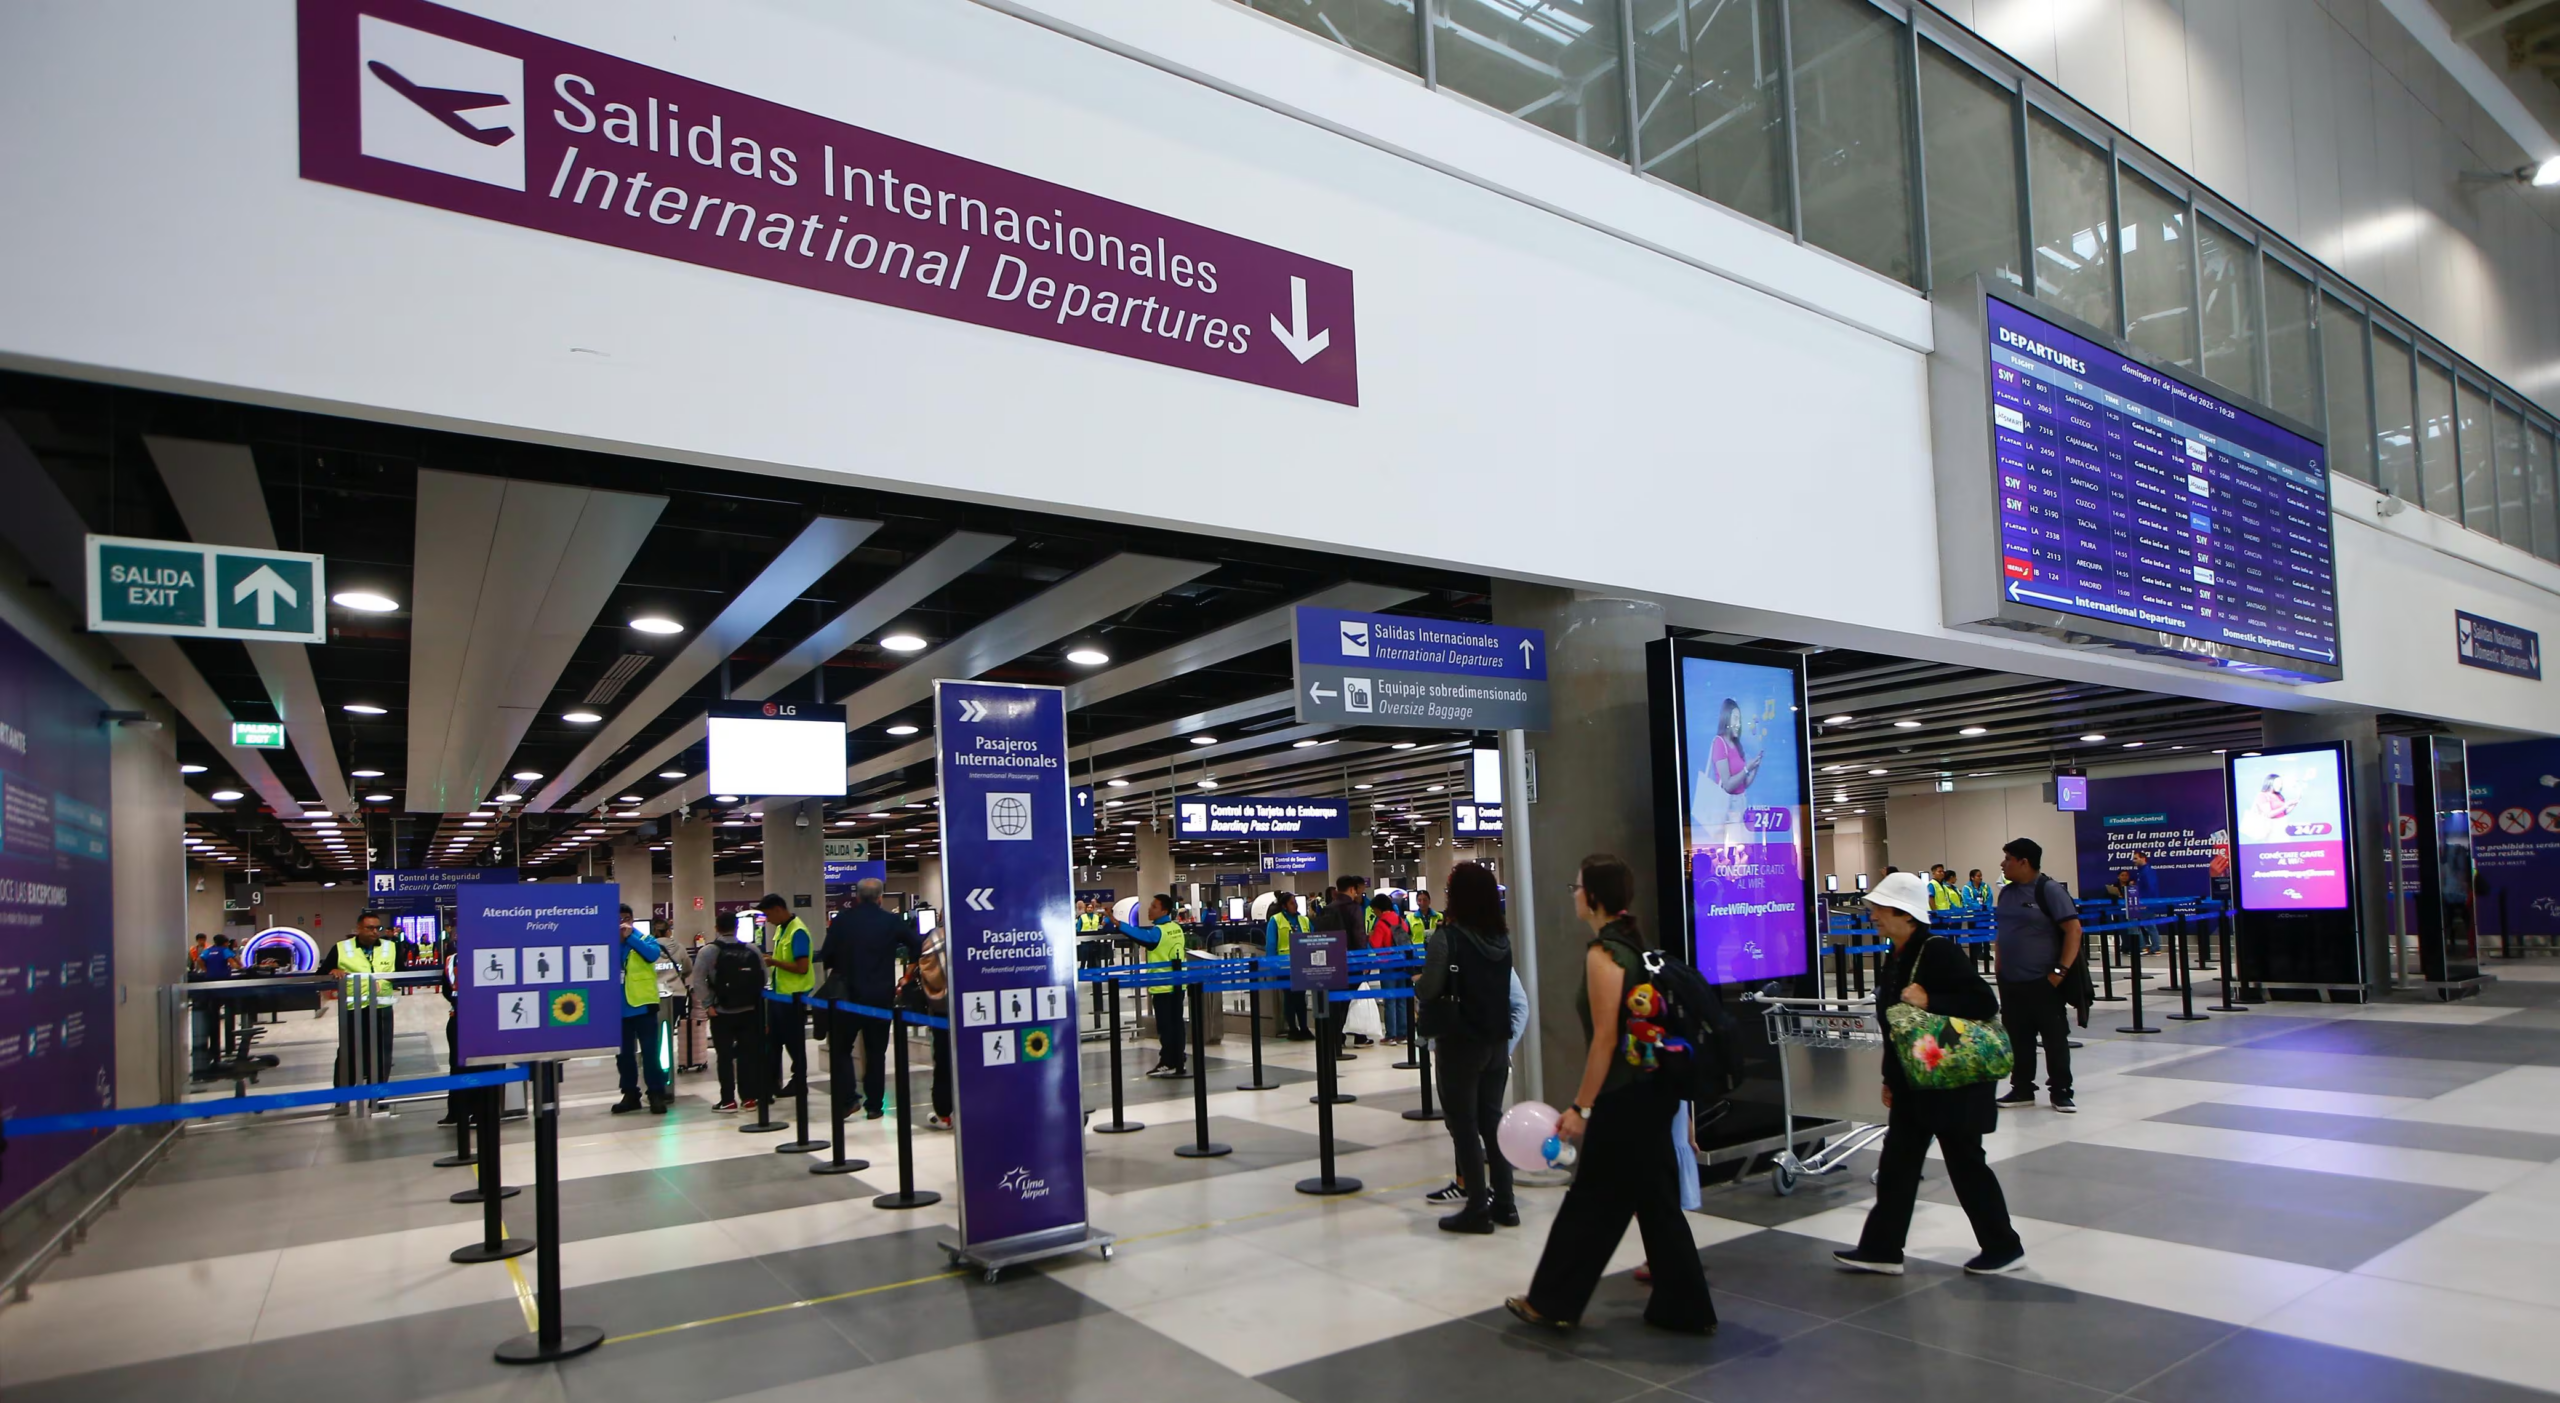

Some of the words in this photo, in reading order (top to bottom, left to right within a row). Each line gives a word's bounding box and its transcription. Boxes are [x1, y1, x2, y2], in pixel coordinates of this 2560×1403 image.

[553, 73, 798, 186] Salidas
[824, 145, 1219, 294] Internacionales
[549, 146, 971, 290] International
[986, 253, 1252, 354] Departures
[1999, 326, 2086, 375] DEPARTURES
[1998, 368, 2014, 383] SKY
[2021, 378, 2031, 387] H2
[2036, 384, 2048, 393] 803
[2065, 395, 2094, 411] SANTIAGO
[2010, 355, 2035, 371] FLIGHT
[2073, 381, 2083, 390] TO
[2104, 394, 2120, 406] TIME
[2126, 403, 2142, 415] GATE
[2157, 416, 2174, 427] STATE
[2121, 364, 2151, 383] domingo
[2152, 377, 2161, 387] 01
[2162, 381, 2171, 391] de
[2171, 384, 2187, 399] junio
[2188, 393, 2198, 403] del
[2198, 397, 2214, 411] 2025
[2219, 406, 2235, 419] 10:28
[2023, 398, 2031, 406] LA
[2038, 404, 2052, 414] 2063
[2070, 416, 2091, 428] CUZCO
[2039, 426, 2053, 436] 7318
[2065, 436, 2098, 452] CAJAMARCA
[2040, 447, 2055, 457] 2450
[2065, 456, 2084, 468] PUNTA
[2085, 463, 2101, 473] CANA
[2191, 462, 2203, 474] SKY
[2027, 463, 2035, 471] LA
[2041, 468, 2052, 476] 645
[2070, 477, 2099, 491] SANTIAGO
[2005, 476, 2021, 489] SKY
[2028, 484, 2037, 492] H2
[2043, 488, 2057, 498] 5015
[2075, 498, 2096, 510] CUZCO
[2006, 498, 2022, 511] SKY
[2030, 505, 2039, 514] H2
[2044, 509, 2059, 519] 5190
[2077, 519, 2097, 530] TACNA
[2031, 527, 2039, 535] LA
[2045, 531, 2060, 540] 2338
[2080, 540, 2096, 550] PIURA
[2032, 548, 2040, 556] LA
[2046, 552, 2061, 561] 2113
[2076, 559, 2103, 571] AREQUIPA
[111, 564, 195, 588] SALIDA
[2007, 564, 2023, 573] IBERIA
[2048, 572, 2059, 581] 124
[2079, 579, 2102, 590] MADRID
[128, 587, 179, 607] EXIT
[2075, 596, 2137, 618] International
[2139, 609, 2186, 628] Departures
[1374, 623, 1415, 641] Salidas
[1419, 627, 1499, 649] Internacionales
[2222, 628, 2257, 644] Domestic
[2258, 635, 2295, 651] Departures
[2472, 622, 2494, 643] Salidas
[2493, 627, 2523, 650] Nacionales
[1375, 644, 1446, 663] International
[1448, 650, 1503, 668] Departures
[2475, 642, 2500, 663] Domestic
[2500, 649, 2529, 670] Departures
[1378, 679, 1425, 698] Equipaje
[1429, 683, 1528, 701] sobredimensionado
[779, 705, 796, 716] LG
[1379, 699, 1424, 715] Oversize
[1428, 702, 1473, 721] Baggage
[976, 736, 1037, 754] Pasajeros
[955, 751, 1058, 768] Internacionales
[1007, 773, 1039, 781] Passengers
[1210, 804, 1242, 817] Control
[1244, 805, 1255, 817] de
[1255, 805, 1285, 819] Tarjeta
[1286, 805, 1297, 817] de
[1298, 805, 1338, 819] Embarque
[1754, 812, 1784, 829] 24/7
[2109, 815, 2164, 824] #TodoBajoControl
[1210, 820, 1249, 834] Boarding
[1250, 821, 1270, 831] Pass
[1271, 820, 1301, 831] Control
[2107, 833, 2124, 841] Ten
[2136, 831, 2147, 839] la
[2149, 831, 2180, 839] mano
[2182, 829, 2194, 837] tu
[2294, 825, 2324, 835] 24/7
[825, 844, 850, 856] SALIDA
[2107, 840, 2165, 850] documento
[2168, 838, 2182, 848] de
[2183, 837, 2229, 847] identida
[2107, 853, 2113, 861] y
[2116, 851, 2151, 861] tarja
[2153, 849, 2167, 857] de
[2169, 847, 2226, 858] embarque
[1390, 864, 1395, 873] 3
[1400, 864, 1405, 873] 3
[1490, 862, 1495, 871] 2
[1760, 864, 1785, 875] GRATIS
[399, 874, 428, 882] Control
[441, 873, 481, 882] Seguridad
[1096, 871, 1102, 881] 5
[1737, 879, 1747, 889] AL
[399, 883, 431, 892] Security
[252, 891, 261, 905] 9
[482, 906, 532, 917] Atención
[535, 905, 599, 919] preferencial
[1707, 901, 1796, 917] .FreeWifiJorgeChavez
[526, 921, 559, 932] Priority
[983, 928, 1044, 946] Pasajeros
[967, 943, 1054, 961] Preferenciale
[981, 965, 1015, 974] Preferential
[1014, 964, 1047, 973] passengers
[1021, 1187, 1049, 1200] Airport
[1022, 1179, 1045, 1190] Lima
